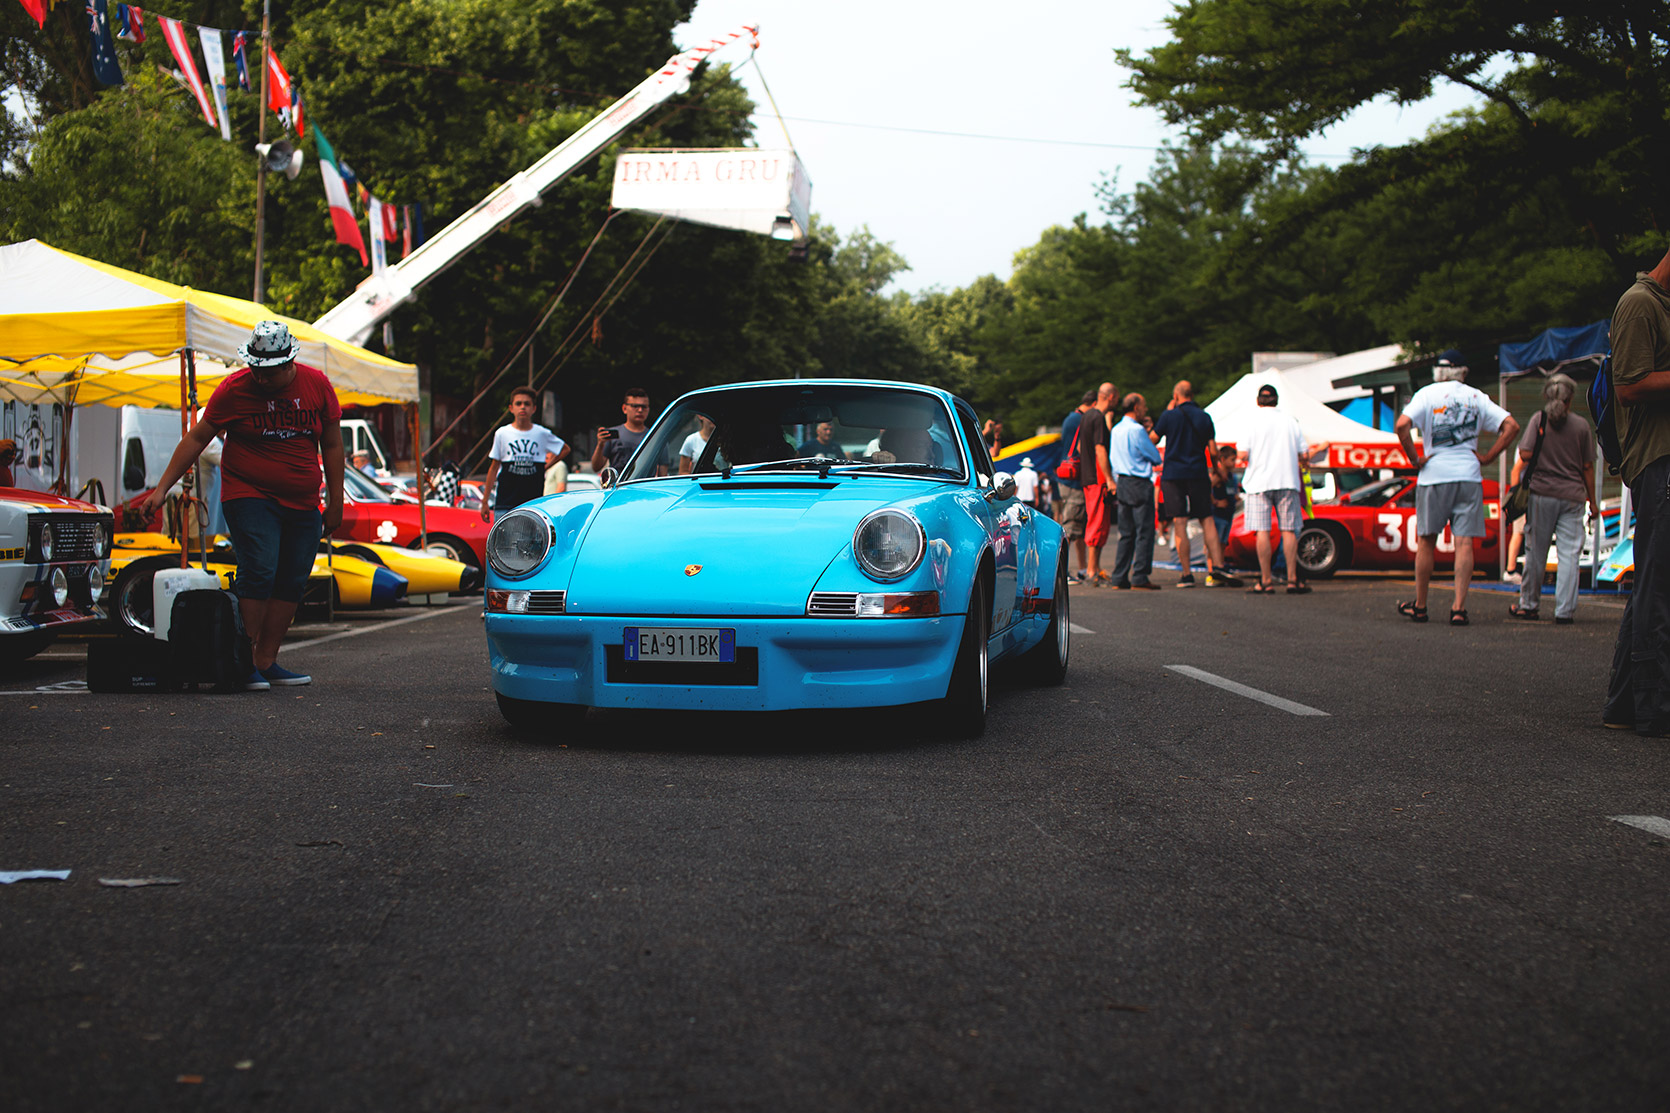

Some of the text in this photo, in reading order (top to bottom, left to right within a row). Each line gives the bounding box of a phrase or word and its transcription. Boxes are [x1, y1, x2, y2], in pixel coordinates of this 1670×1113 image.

[622, 159, 781, 182] IRMA GRU
[251, 409, 317, 429] DIVISION
[1331, 444, 1411, 468] TOTA
